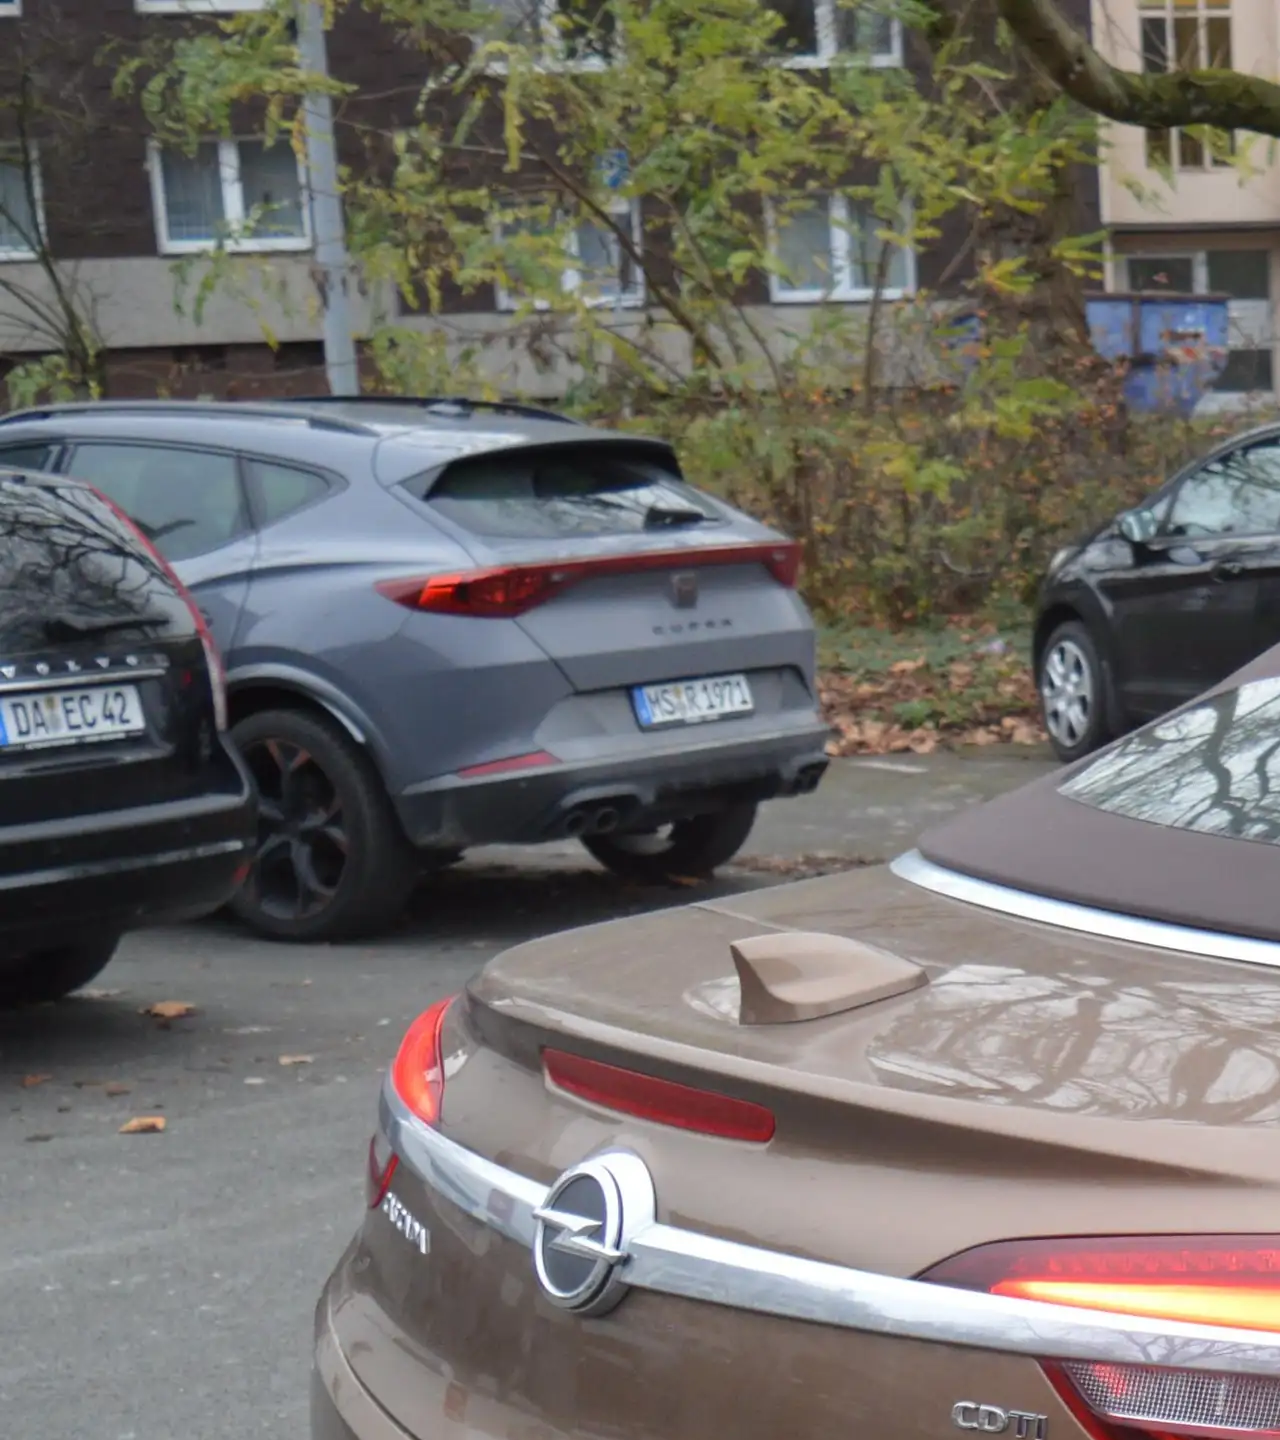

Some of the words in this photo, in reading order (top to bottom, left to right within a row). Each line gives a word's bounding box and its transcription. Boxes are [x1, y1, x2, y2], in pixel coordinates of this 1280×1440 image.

[0, 655, 139, 678] VOLVO
[10, 701, 48, 736] DA
[61, 694, 97, 730] EC
[102, 691, 131, 725] 42
